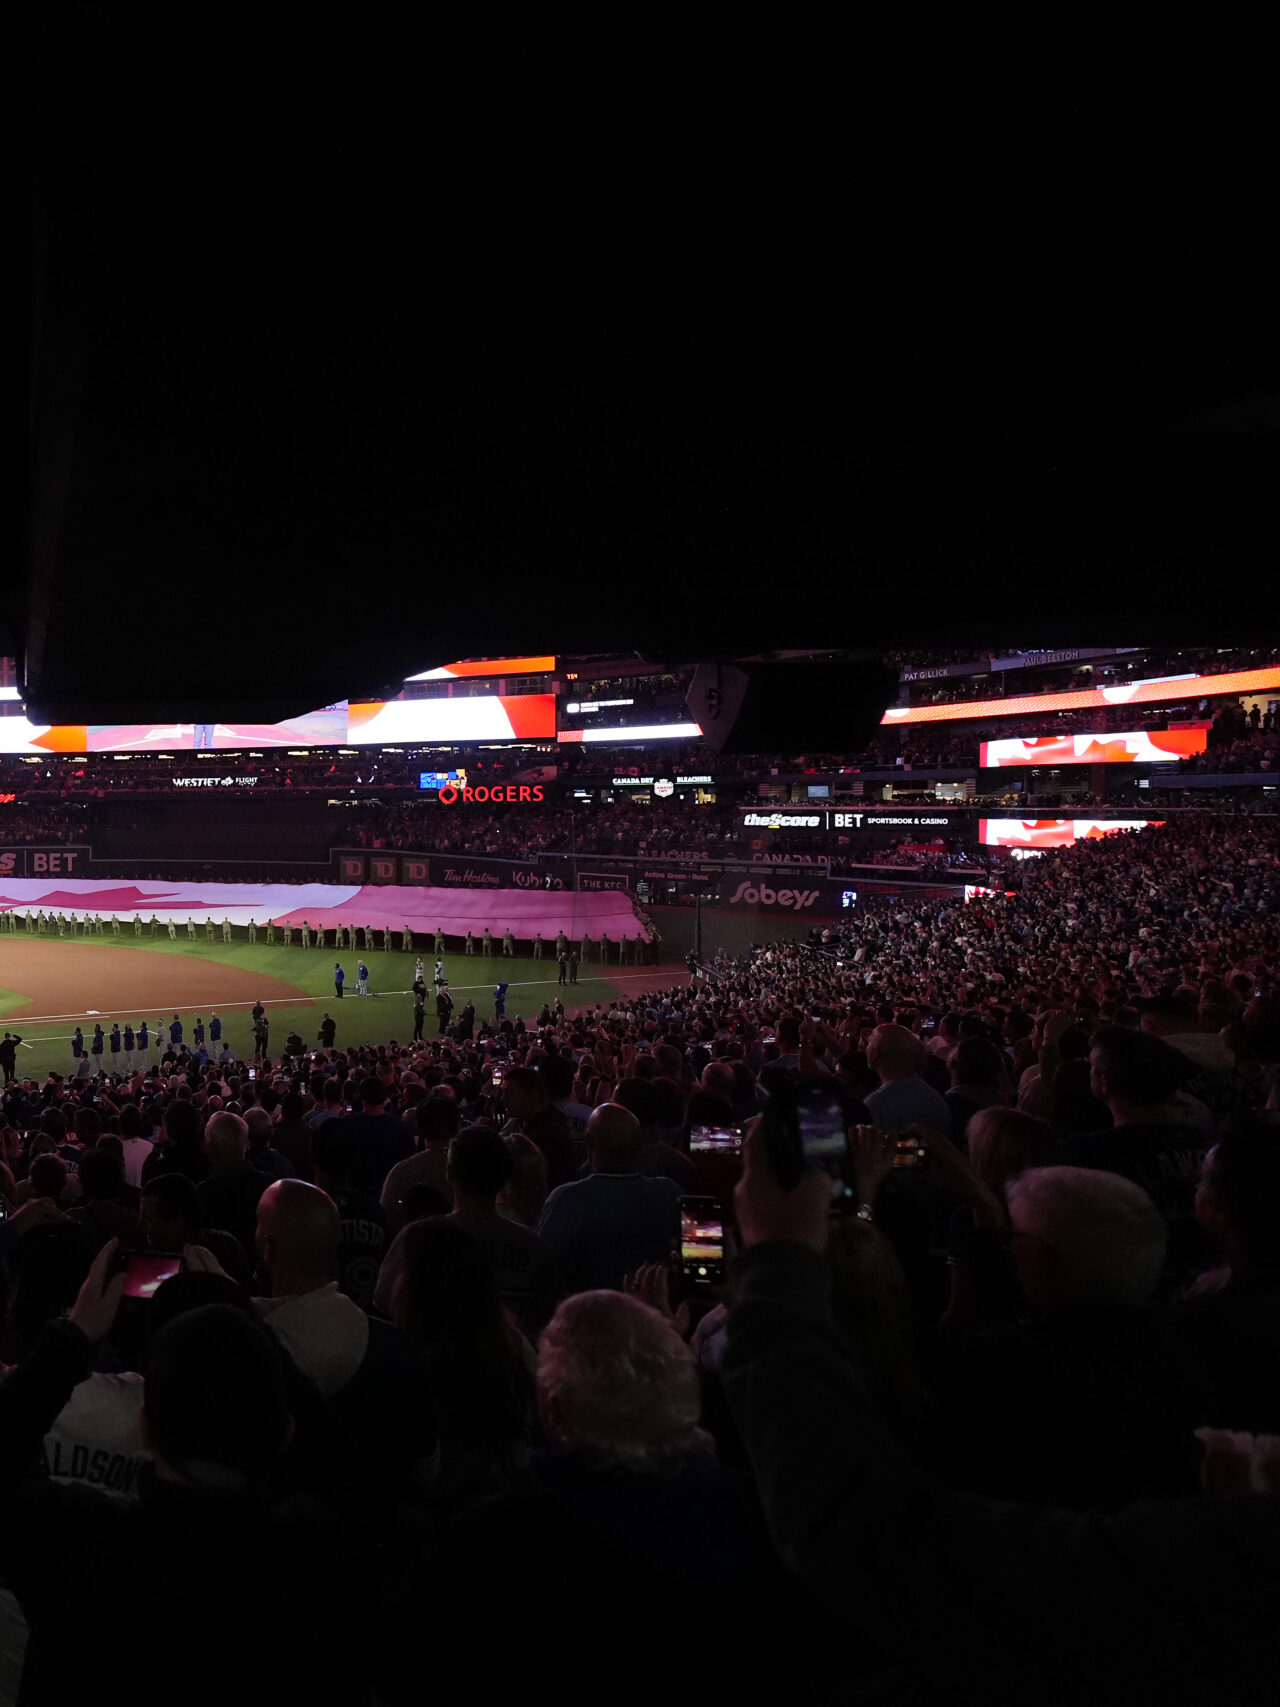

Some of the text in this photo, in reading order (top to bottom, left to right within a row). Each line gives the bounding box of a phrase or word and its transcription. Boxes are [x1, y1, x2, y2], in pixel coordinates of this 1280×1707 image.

[903, 668, 950, 681] PAT GILLICK
[463, 785, 544, 802] ROGERS
[744, 813, 820, 827] theScore
[834, 813, 864, 828] BET
[867, 817, 913, 825] SPORTSBOOK
[920, 817, 949, 825] CASINO
[33, 852, 77, 872] BET
[638, 850, 709, 860] LEACHERS
[344, 860, 362, 877] TD
[373, 861, 394, 878] TD
[405, 862, 428, 879] TD
[444, 869, 500, 884] Tim Hortons
[583, 880, 601, 889] THE
[729, 881, 820, 910] Sobeys
[341, 1217, 388, 1248] TISTA
